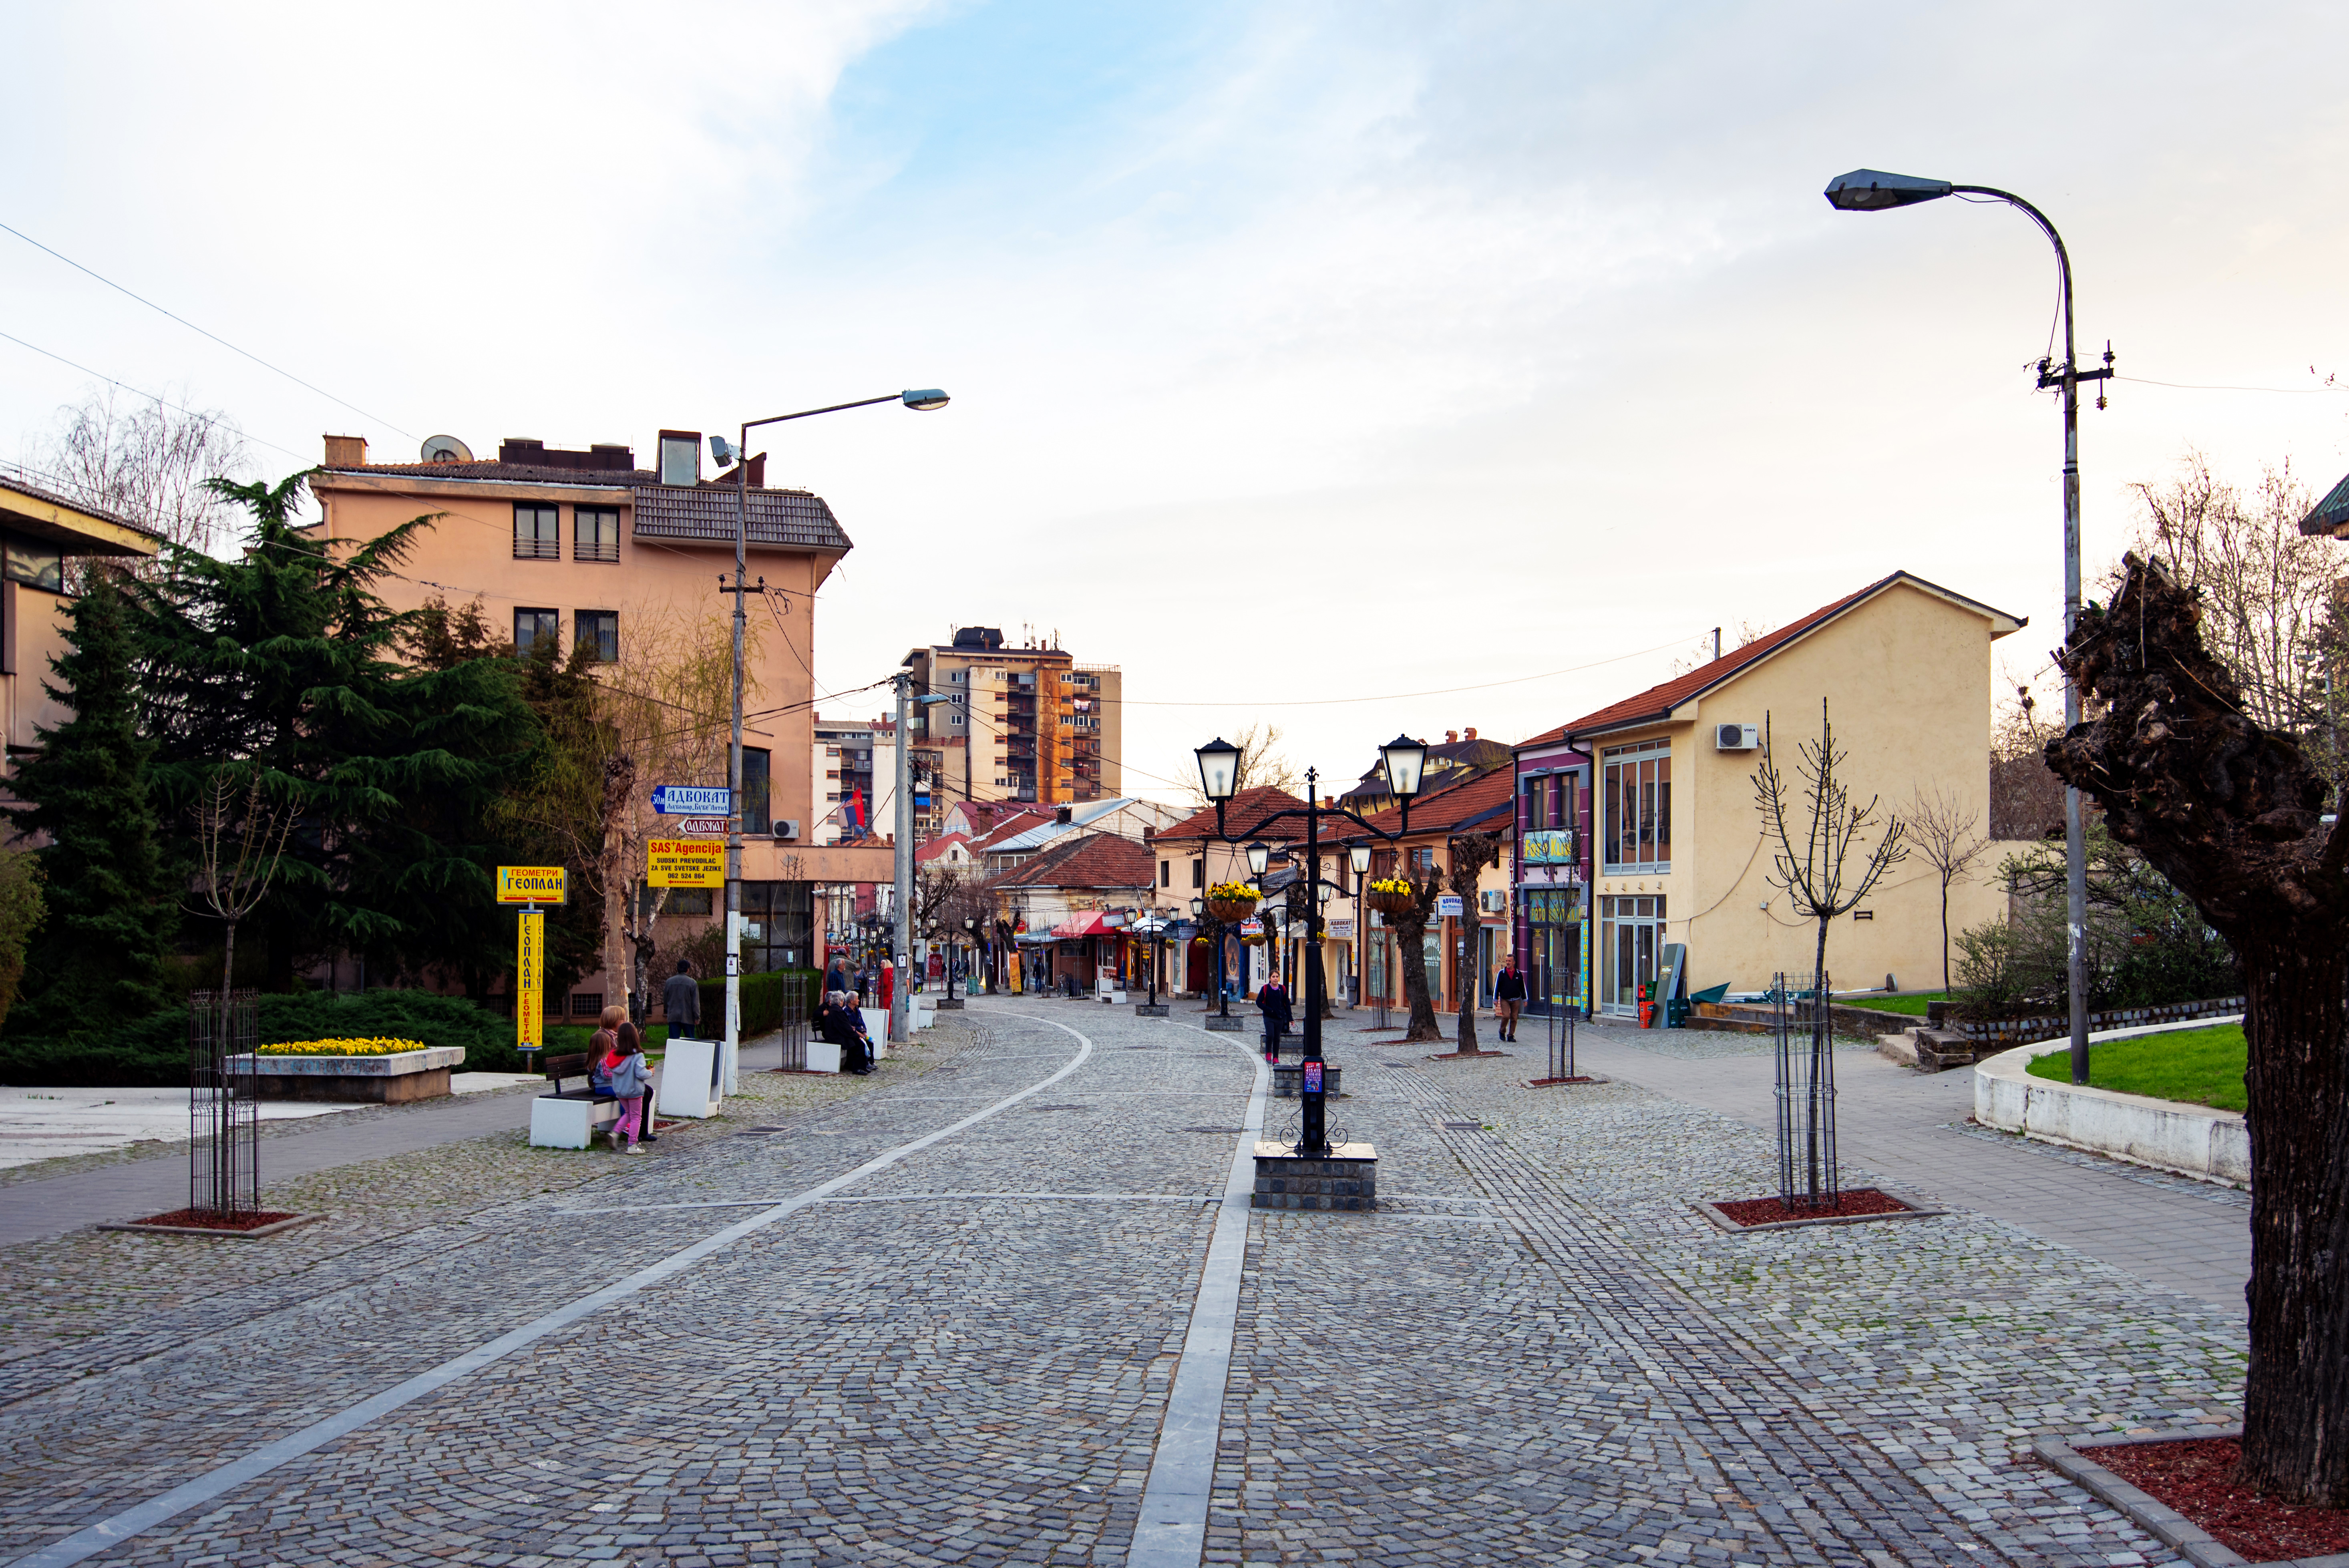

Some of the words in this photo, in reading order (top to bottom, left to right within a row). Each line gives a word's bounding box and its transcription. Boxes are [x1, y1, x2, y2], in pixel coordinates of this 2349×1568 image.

[667, 790, 728, 804] АДВОКАТ
[686, 820, 725, 832] АДВОКАТ
[508, 878, 562, 890] ГЕОПЛАН
[1531, 908, 1546, 921] FOTO
